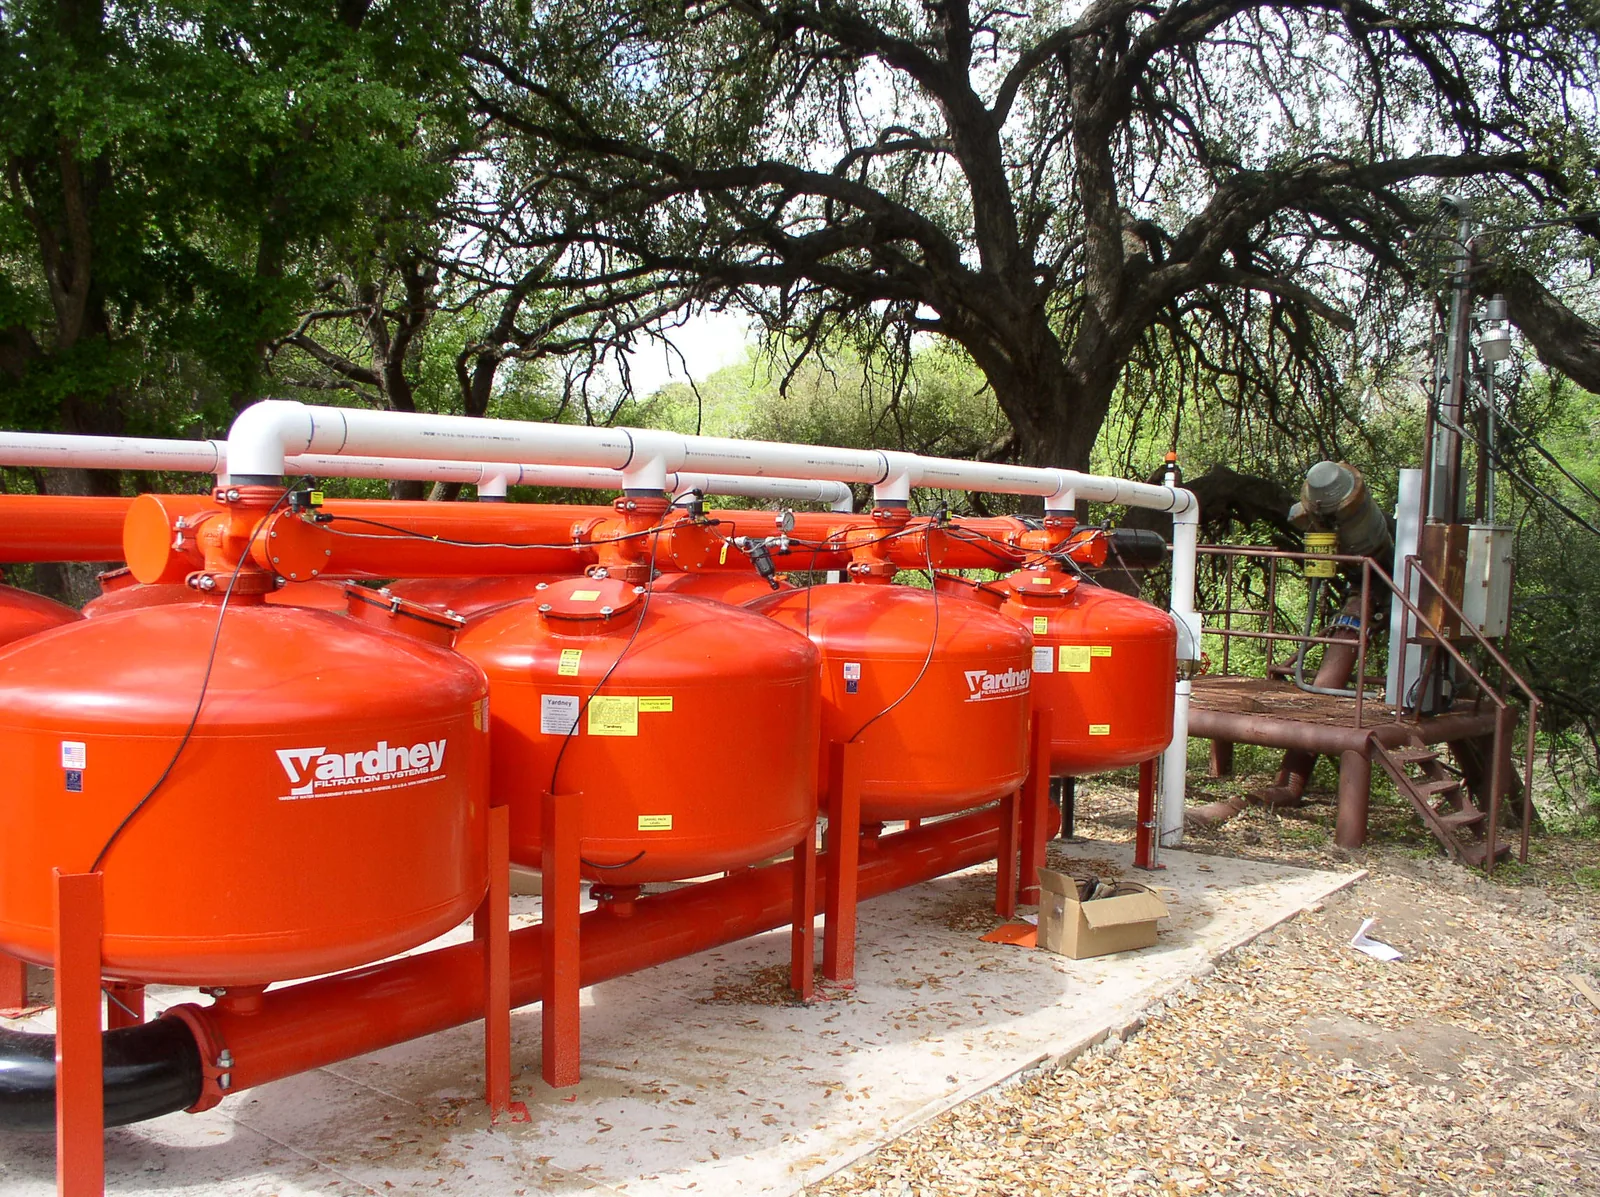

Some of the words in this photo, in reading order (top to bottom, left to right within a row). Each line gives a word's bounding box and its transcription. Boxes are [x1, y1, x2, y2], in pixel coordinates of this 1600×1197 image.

[964, 667, 1031, 699] Yardney
[547, 698, 572, 707] Yardney
[275, 739, 447, 796] Yardney
[314, 771, 381, 788] FILTRATION
[382, 767, 429, 781] SYSTEMS
